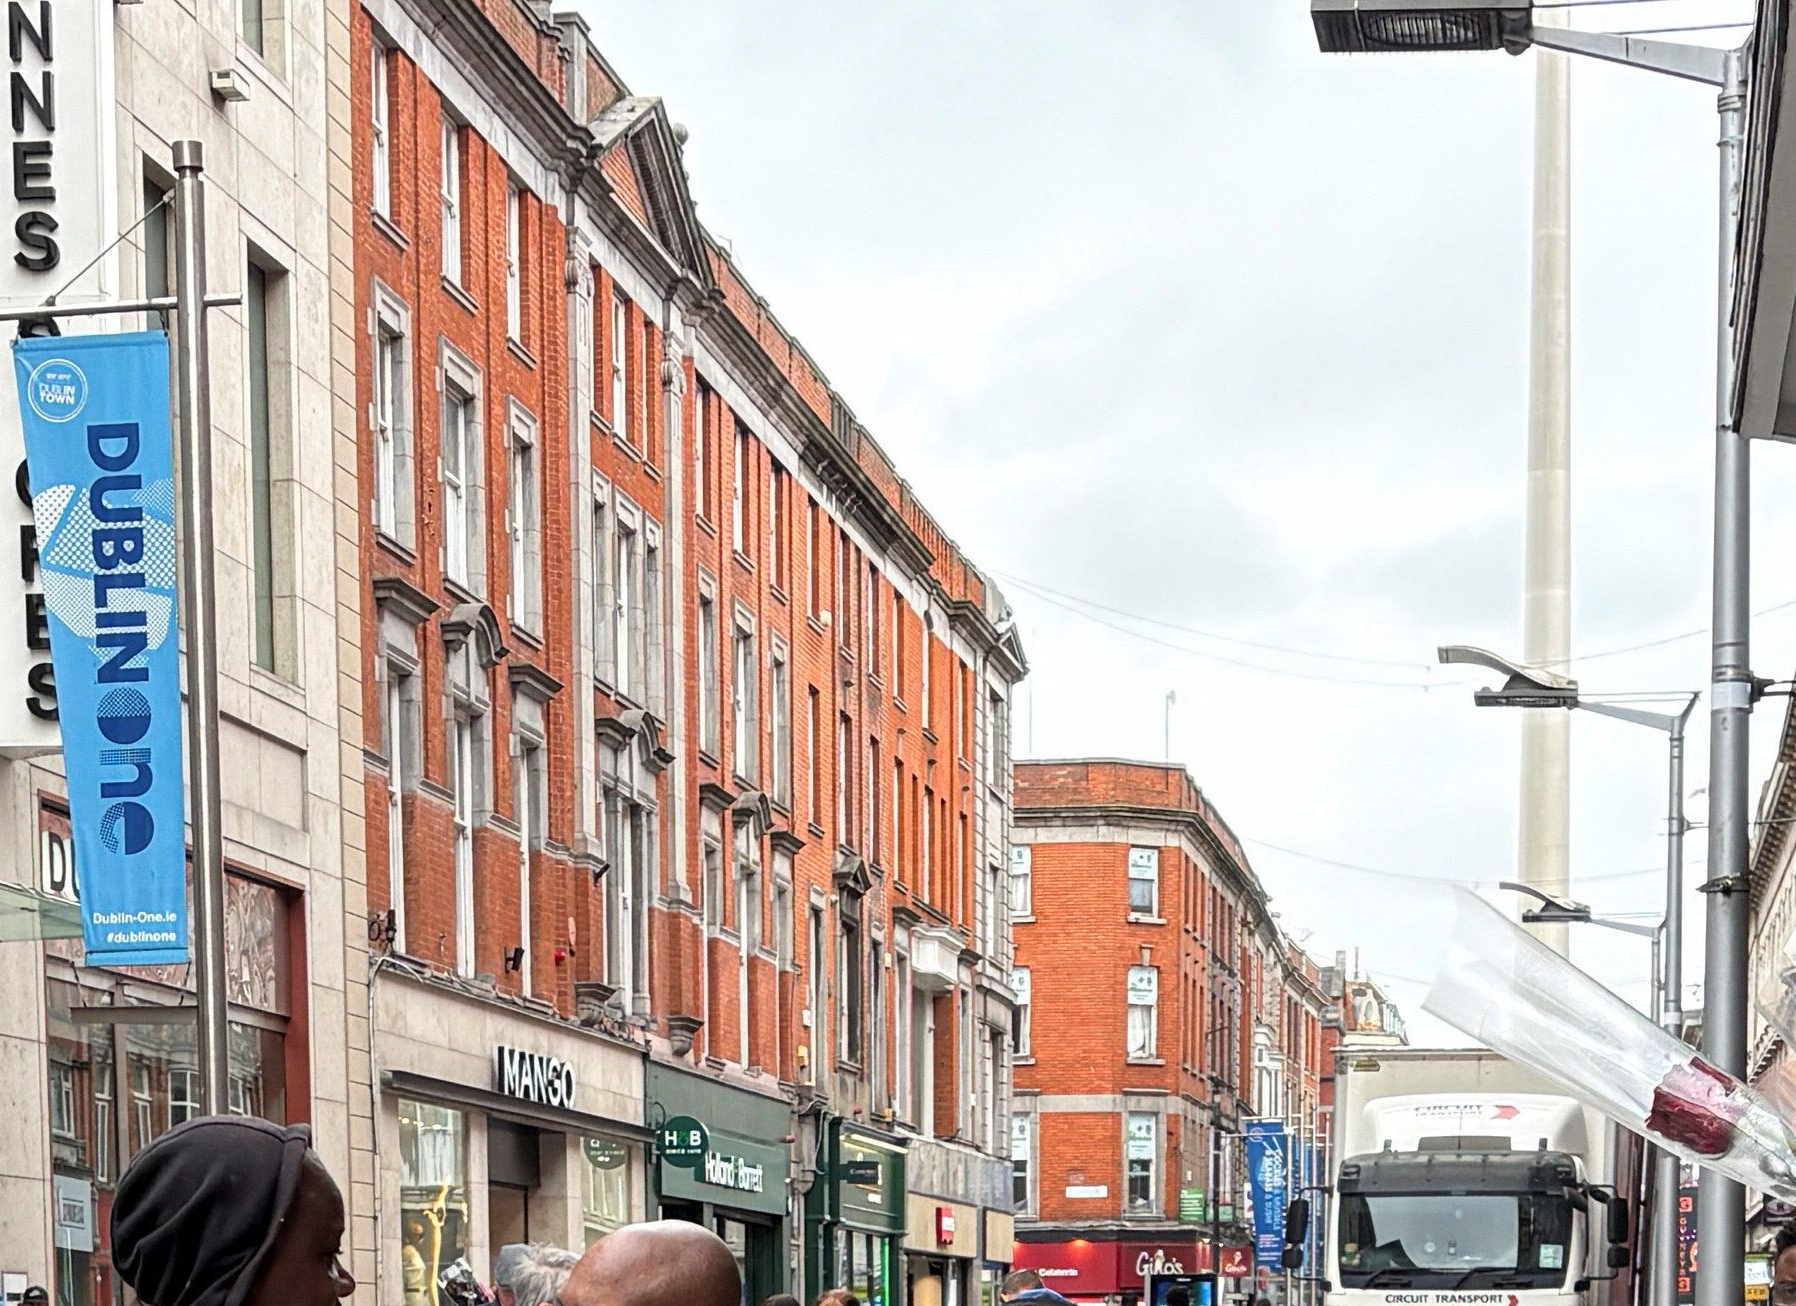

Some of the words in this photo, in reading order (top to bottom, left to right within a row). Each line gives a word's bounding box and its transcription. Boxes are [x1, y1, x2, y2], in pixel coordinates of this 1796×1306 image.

[39, 391, 75, 405] TOWN
[93, 911, 177, 925] Dublin-One.ie
[107, 931, 177, 943] #dublinone
[494, 1045, 576, 1109] MANGO
[1385, 1294, 1428, 1304] CIRCUIT
[1435, 1294, 1503, 1304] TRANSPORT
